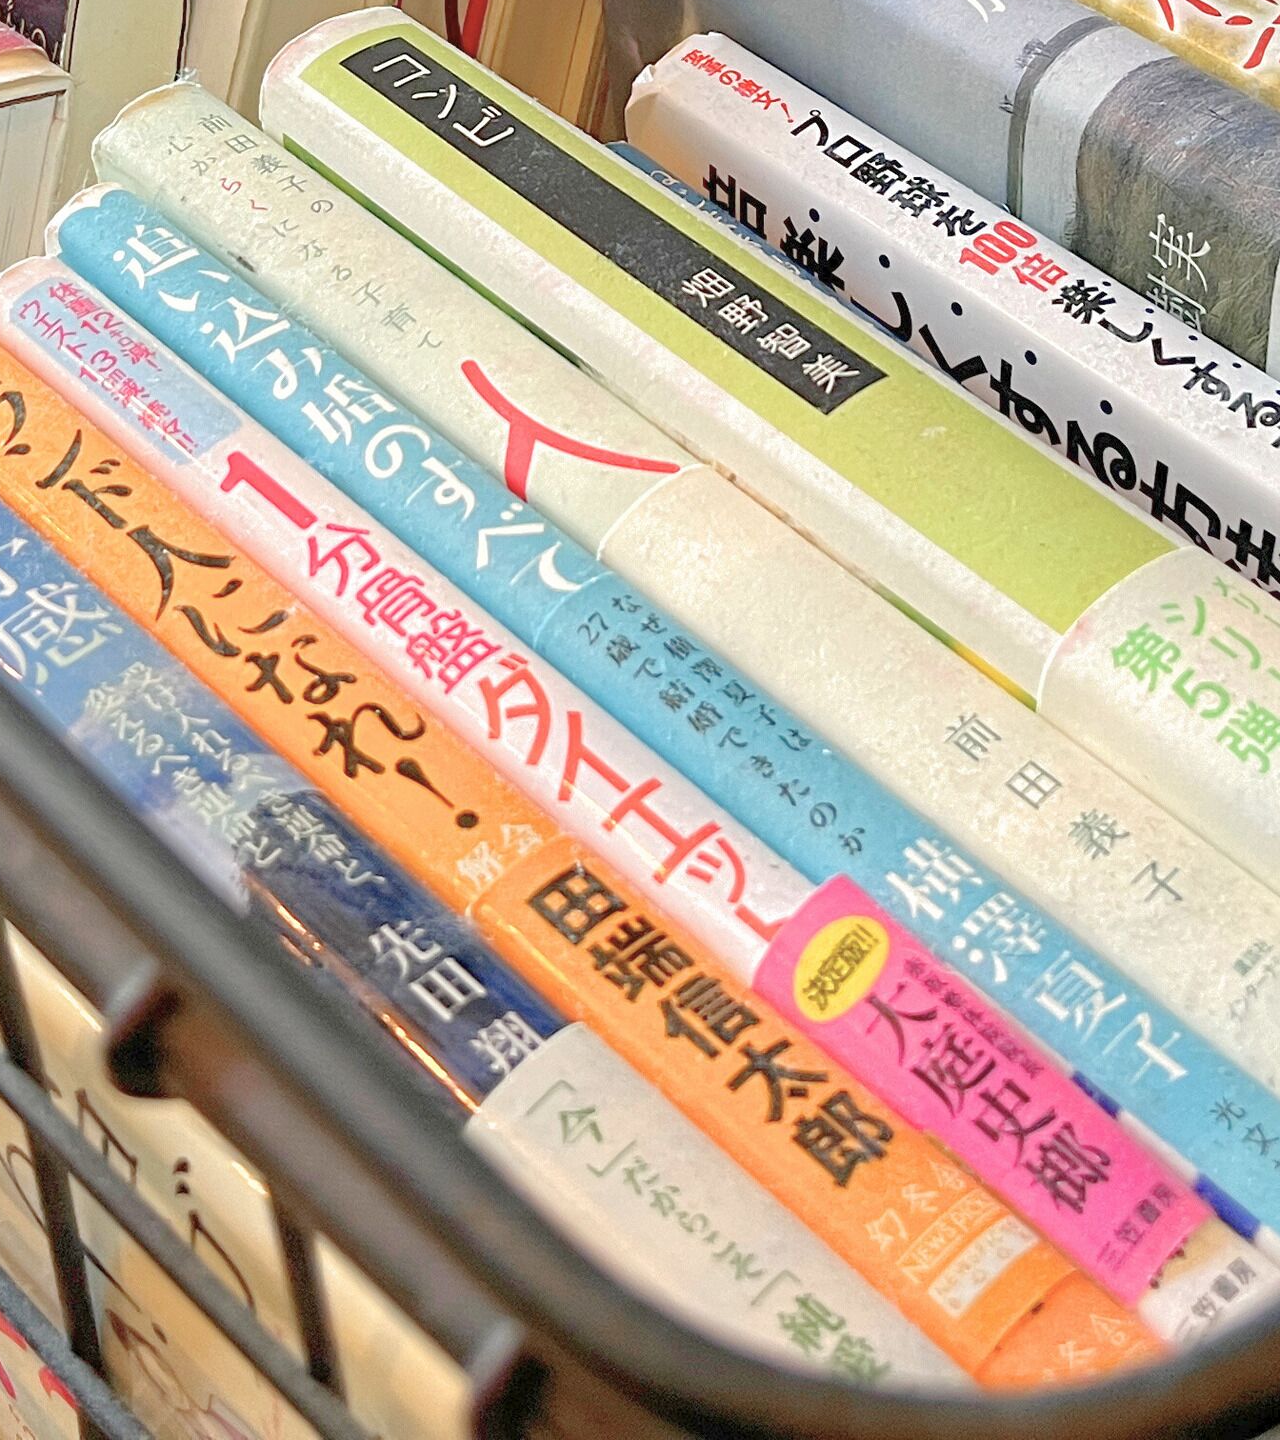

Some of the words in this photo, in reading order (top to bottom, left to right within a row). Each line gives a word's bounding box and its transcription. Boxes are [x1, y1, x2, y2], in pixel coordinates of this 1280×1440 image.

[166, 134, 443, 351] 心がらくになる子育て
[197, 114, 335, 215] 前田義子の
[112, 224, 582, 592] 追い込み婚のすべて
[680, 267, 862, 394] 畑野智美
[577, 612, 866, 856] 27歳で結婚できたのか
[612, 593, 812, 753] なぜ横澤夏子は
[942, 711, 1186, 903] 前田義子
[523, 863, 898, 1191] 田端信太郎
[885, 835, 1189, 1083] 横澤夏子
[863, 1157, 967, 1255] 幻冬舎
